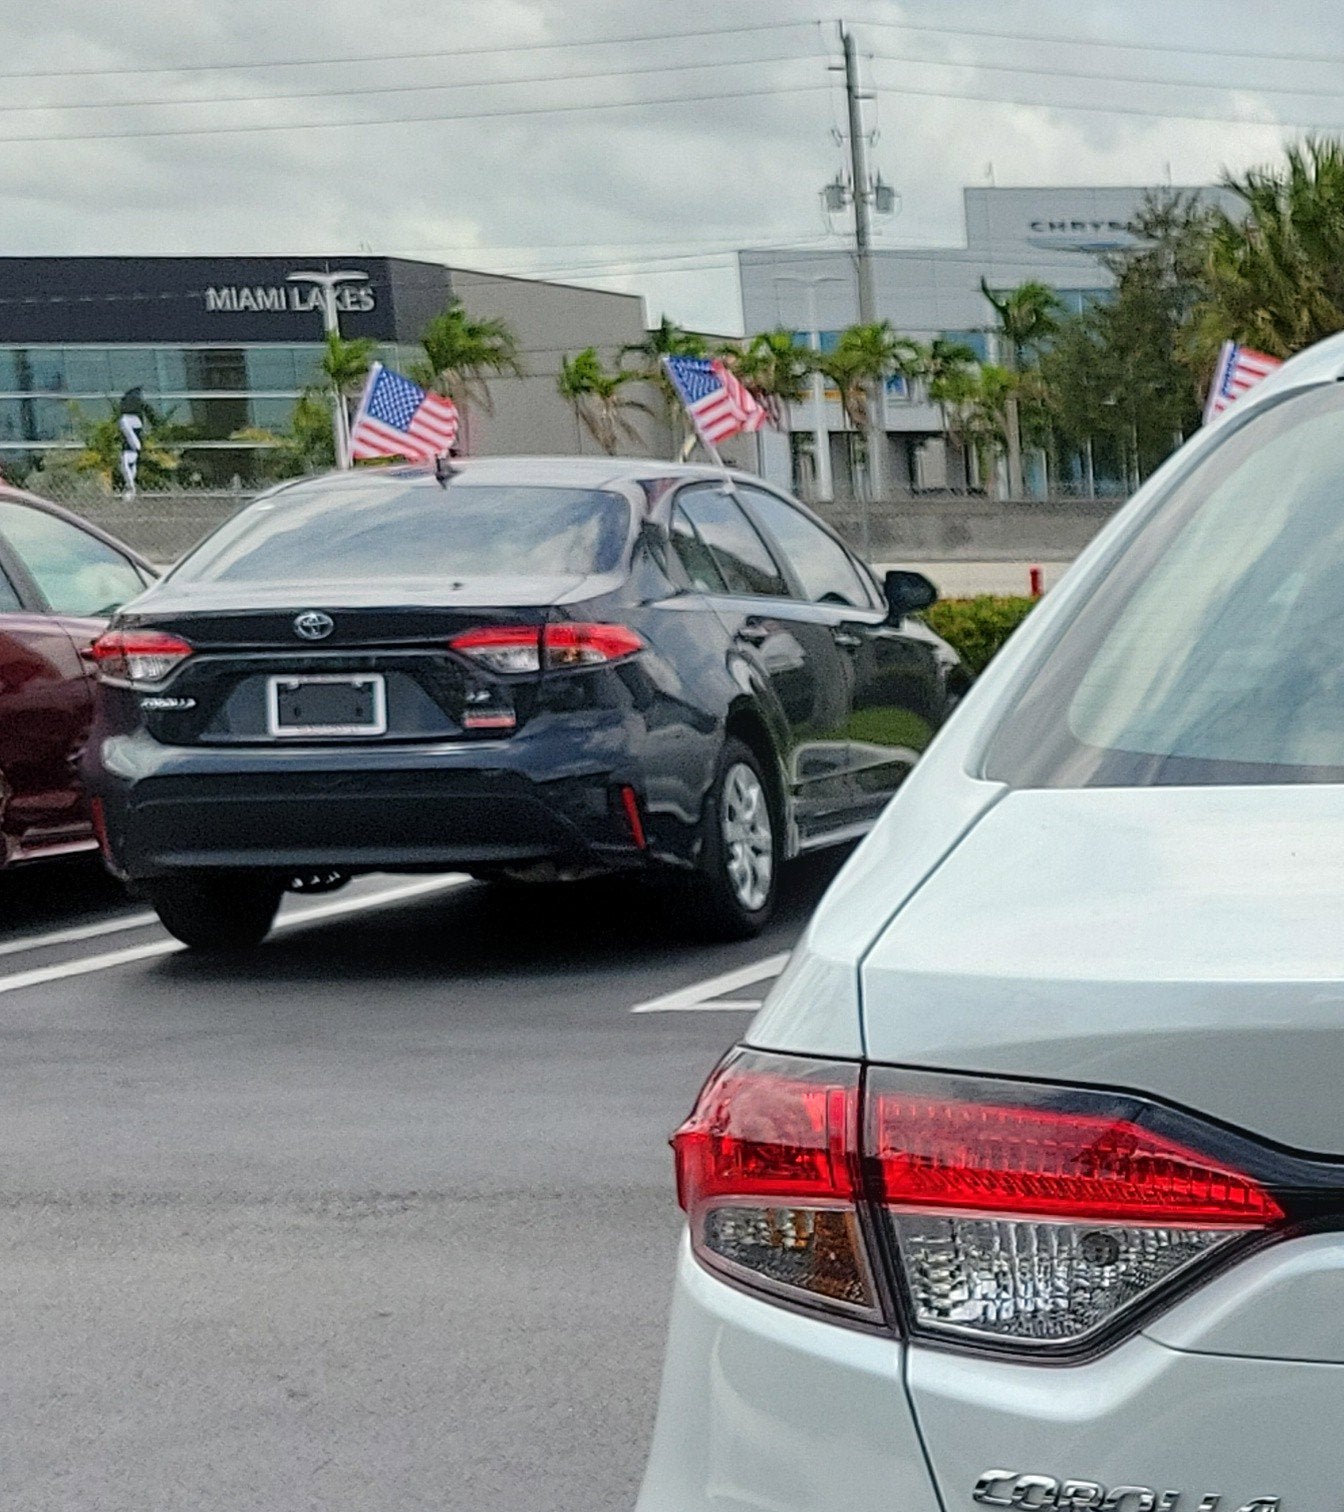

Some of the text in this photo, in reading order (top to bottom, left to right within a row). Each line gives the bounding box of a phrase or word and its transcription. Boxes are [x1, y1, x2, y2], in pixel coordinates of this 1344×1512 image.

[1029, 221, 1148, 233] CHRYSL
[206, 286, 375, 312] MIAMI LAKES
